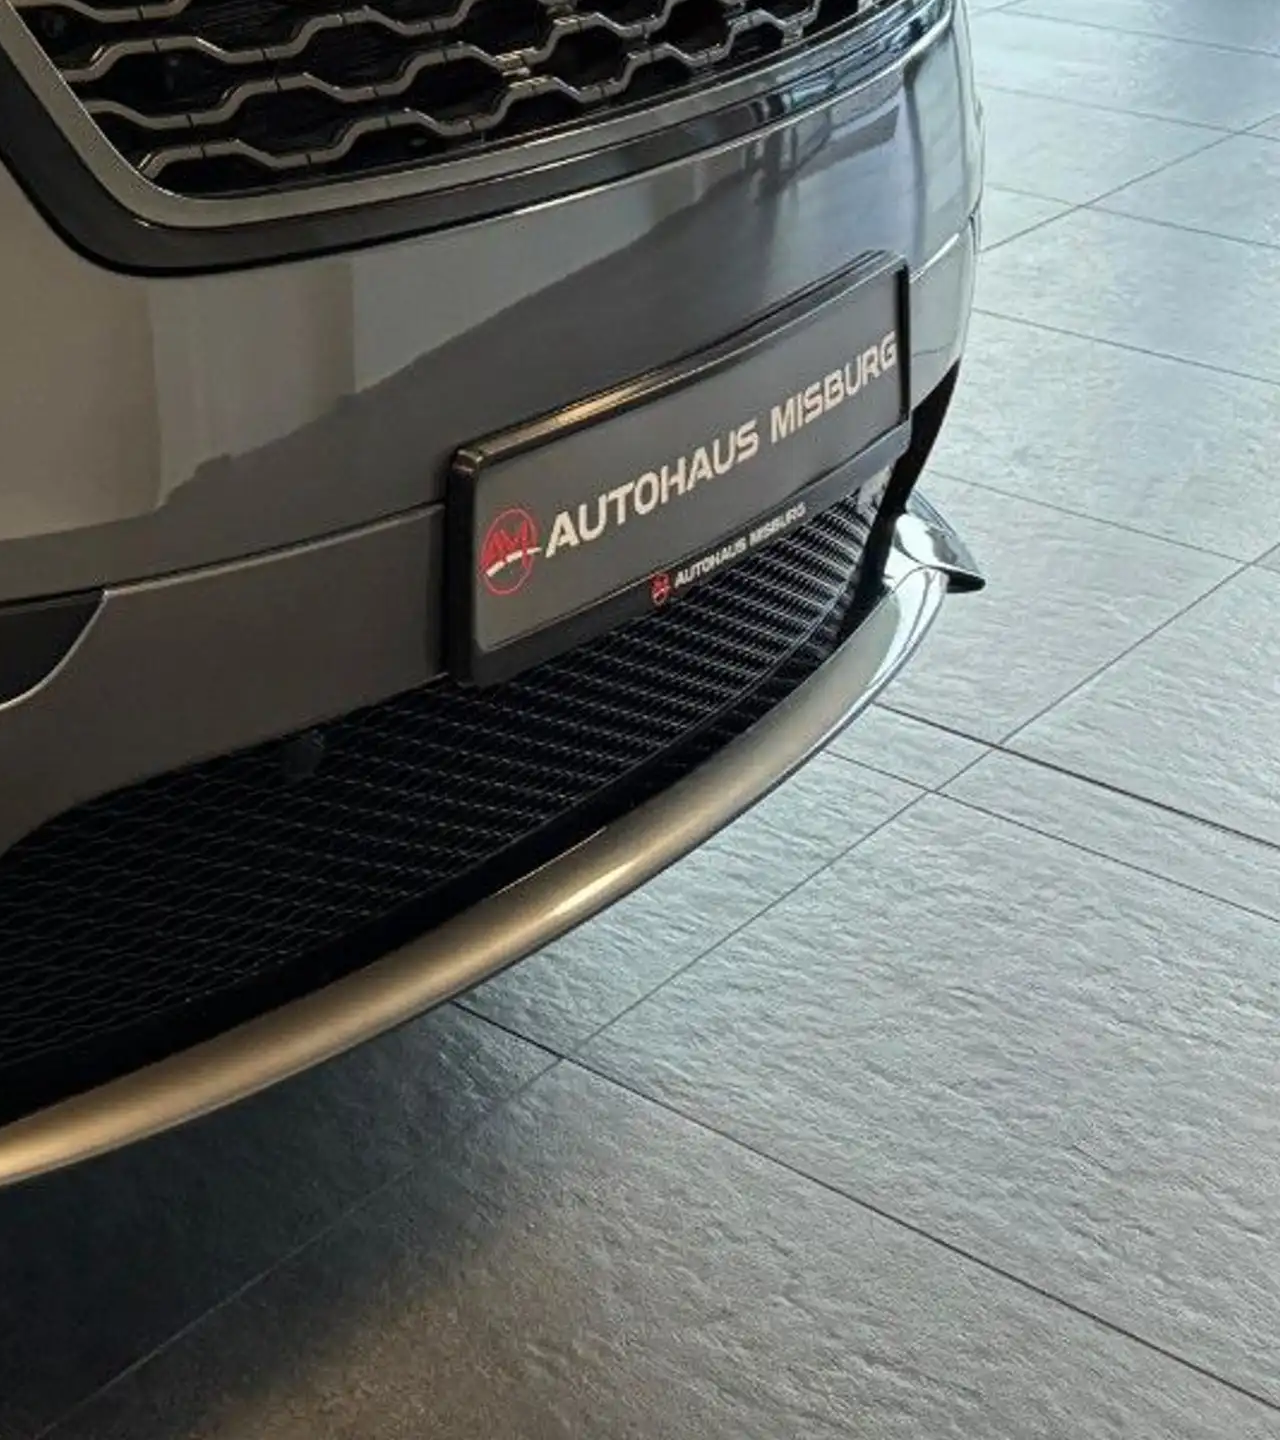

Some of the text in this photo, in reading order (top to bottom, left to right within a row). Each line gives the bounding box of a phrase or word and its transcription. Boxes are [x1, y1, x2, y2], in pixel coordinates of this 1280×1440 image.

[545, 418, 759, 558] AUTOHAUS
[771, 330, 897, 444] MISBURG
[674, 536, 747, 589] AUTOHAUS
